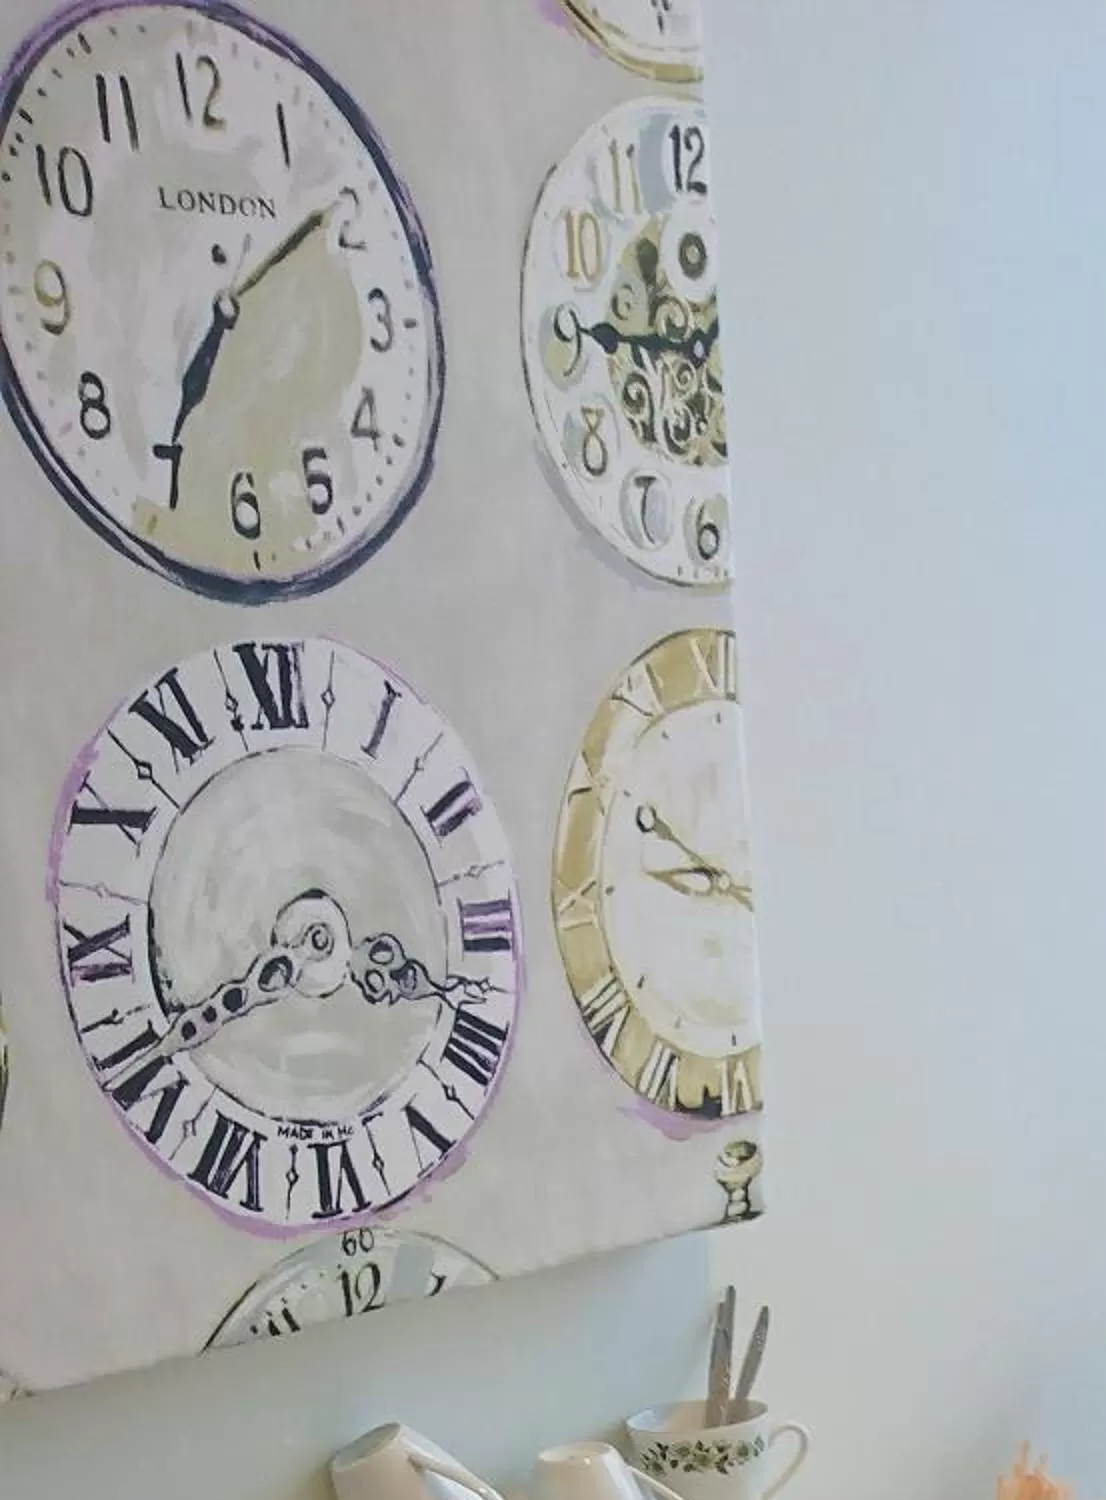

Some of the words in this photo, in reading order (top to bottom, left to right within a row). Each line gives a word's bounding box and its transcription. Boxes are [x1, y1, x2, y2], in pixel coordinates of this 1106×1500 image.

[96, 73, 140, 151] 11
[176, 52, 226, 130] 12
[275, 101, 291, 168] 1
[668, 126, 709, 195] 12
[36, 144, 93, 216] 10
[158, 186, 276, 219] LONDON
[564, 209, 600, 282] 10
[34, 259, 72, 335] 9
[369, 288, 393, 352] 3
[553, 303, 583, 377] 9
[80, 372, 111, 438] 8
[351, 387, 384, 446] 4
[153, 444, 184, 510] 7
[230, 471, 262, 540] 6
[301, 447, 334, 514] 5
[634, 474, 658, 545] 7
[696, 491, 721, 562] 6
[277, 1125, 313, 1140] MADE
[341, 1227, 374, 1256] 60
[340, 1263, 385, 1317] 12
